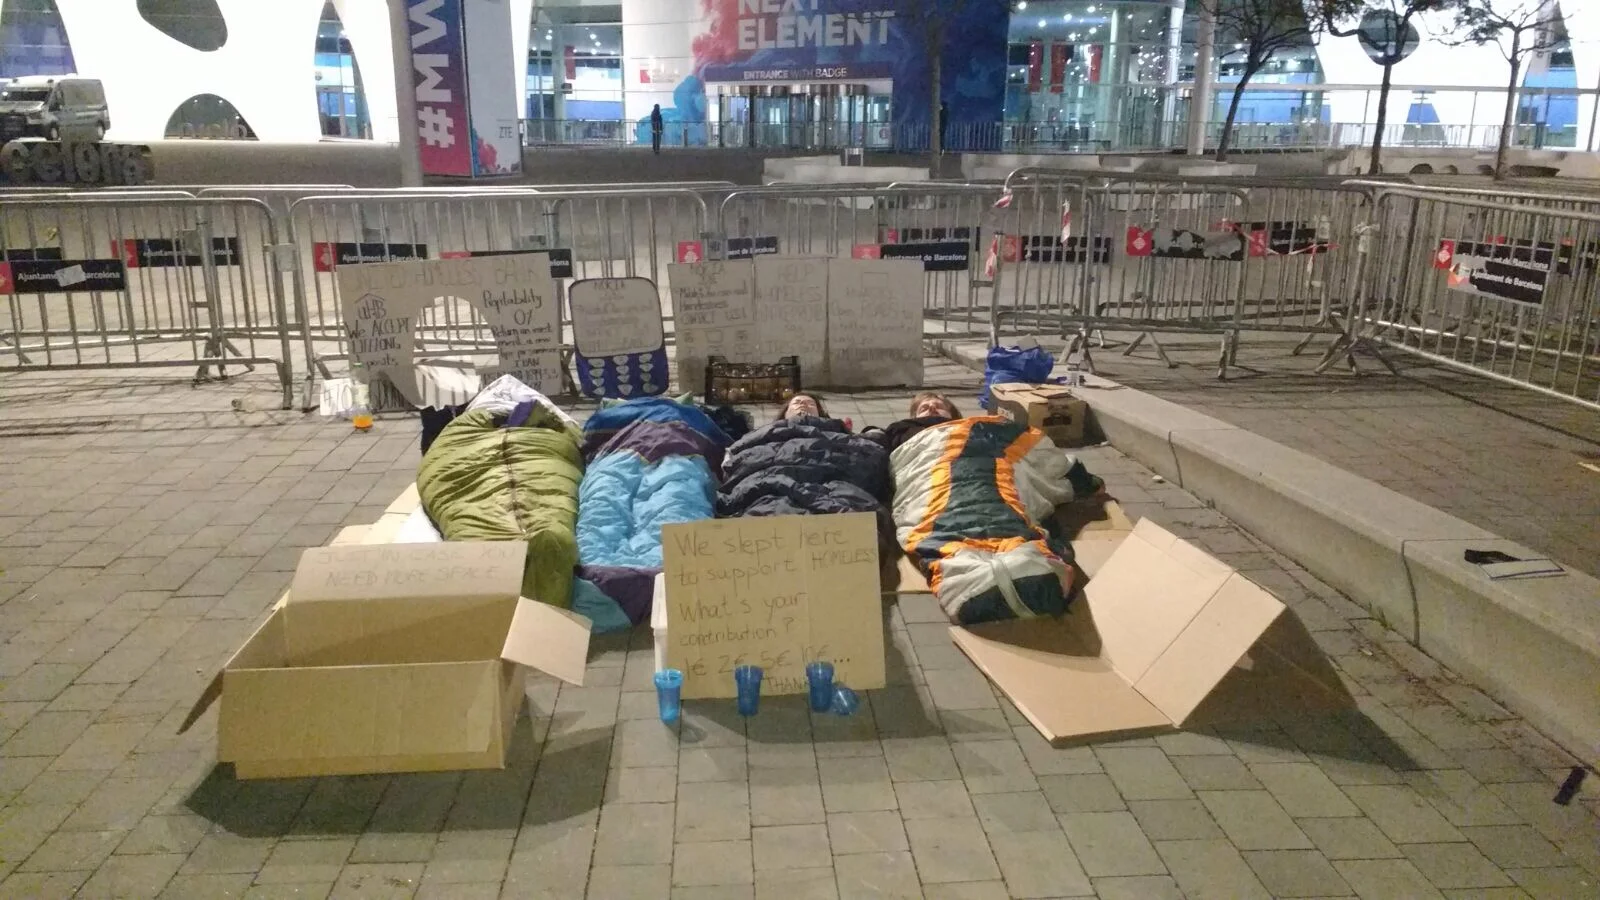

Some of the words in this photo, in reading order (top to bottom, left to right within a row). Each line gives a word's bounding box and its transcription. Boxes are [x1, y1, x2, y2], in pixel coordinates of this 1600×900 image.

[738, 10, 896, 50] ELEMENT
[743, 69, 789, 81] ENTRANCE
[790, 68, 814, 79] WITH
[815, 66, 848, 78] BADGE
[498, 126, 513, 139] ZTE
[934, 253, 967, 261] Barcelona
[1505, 276, 1513, 284] de
[1513, 277, 1543, 291] Barcelona
[343, 320, 366, 339] We
[673, 529, 713, 557] We
[723, 527, 784, 566] slept
[324, 569, 378, 588] NEED
[434, 564, 503, 582] SPACE
[674, 563, 698, 587] to
[706, 557, 798, 597] support
[811, 548, 877, 570] HOMELESS
[763, 591, 808, 624] your
[679, 623, 777, 648] contribution
[782, 616, 795, 633] ?
[760, 649, 793, 671] 5€
